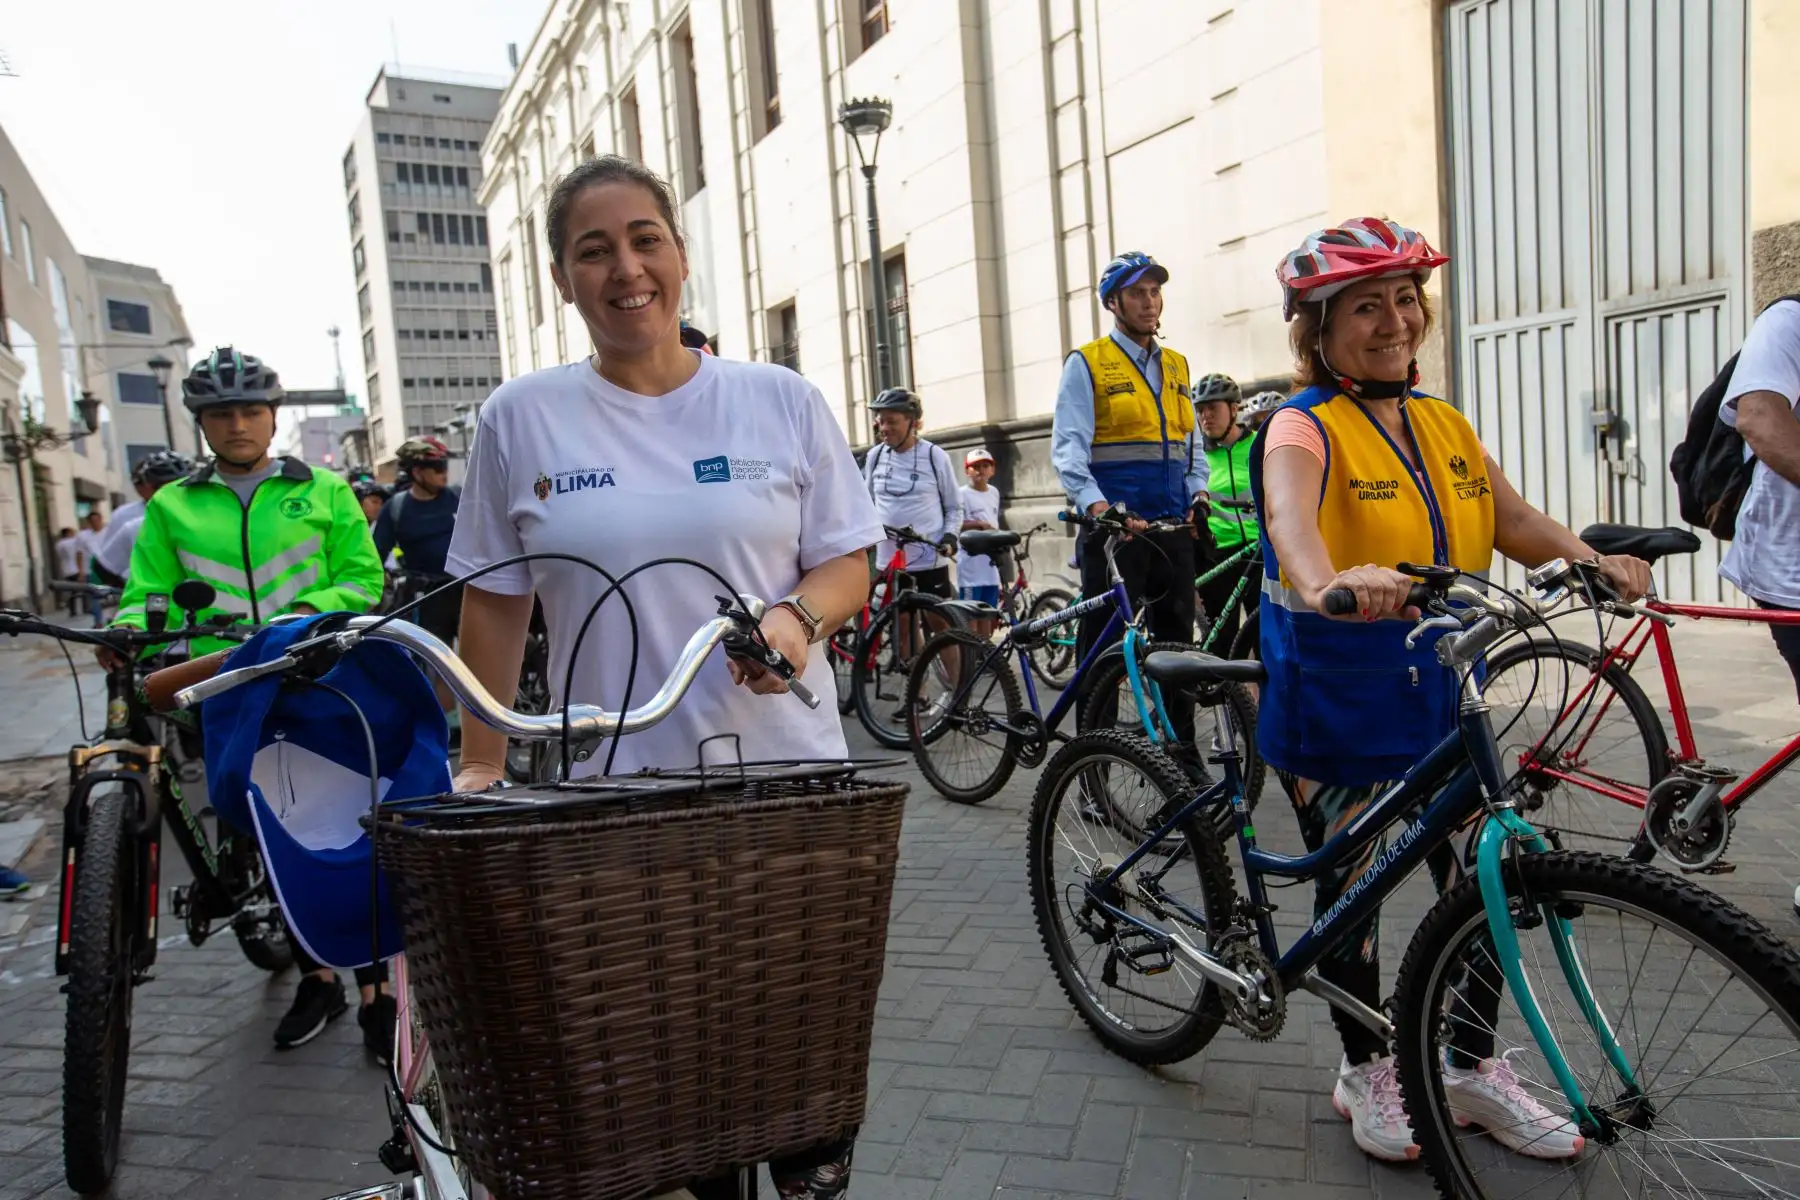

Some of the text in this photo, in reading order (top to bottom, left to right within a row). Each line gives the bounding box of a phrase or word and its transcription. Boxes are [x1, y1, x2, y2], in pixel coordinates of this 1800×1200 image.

[700, 462, 723, 472] bnp
[729, 458, 772, 467] biblioteca
[555, 466, 605, 477] MUNICIPALIDAD
[733, 472, 746, 480] del
[556, 472, 616, 495] LIMA
[1349, 479, 1399, 491] MOVILIDAD
[1358, 490, 1398, 500] URBANA
[1456, 486, 1491, 500] LIMA
[1075, 601, 1088, 614] DE
[1087, 596, 1106, 611] LIMA
[1322, 819, 1425, 926] MUNICIPALIDAD DE LIMA
